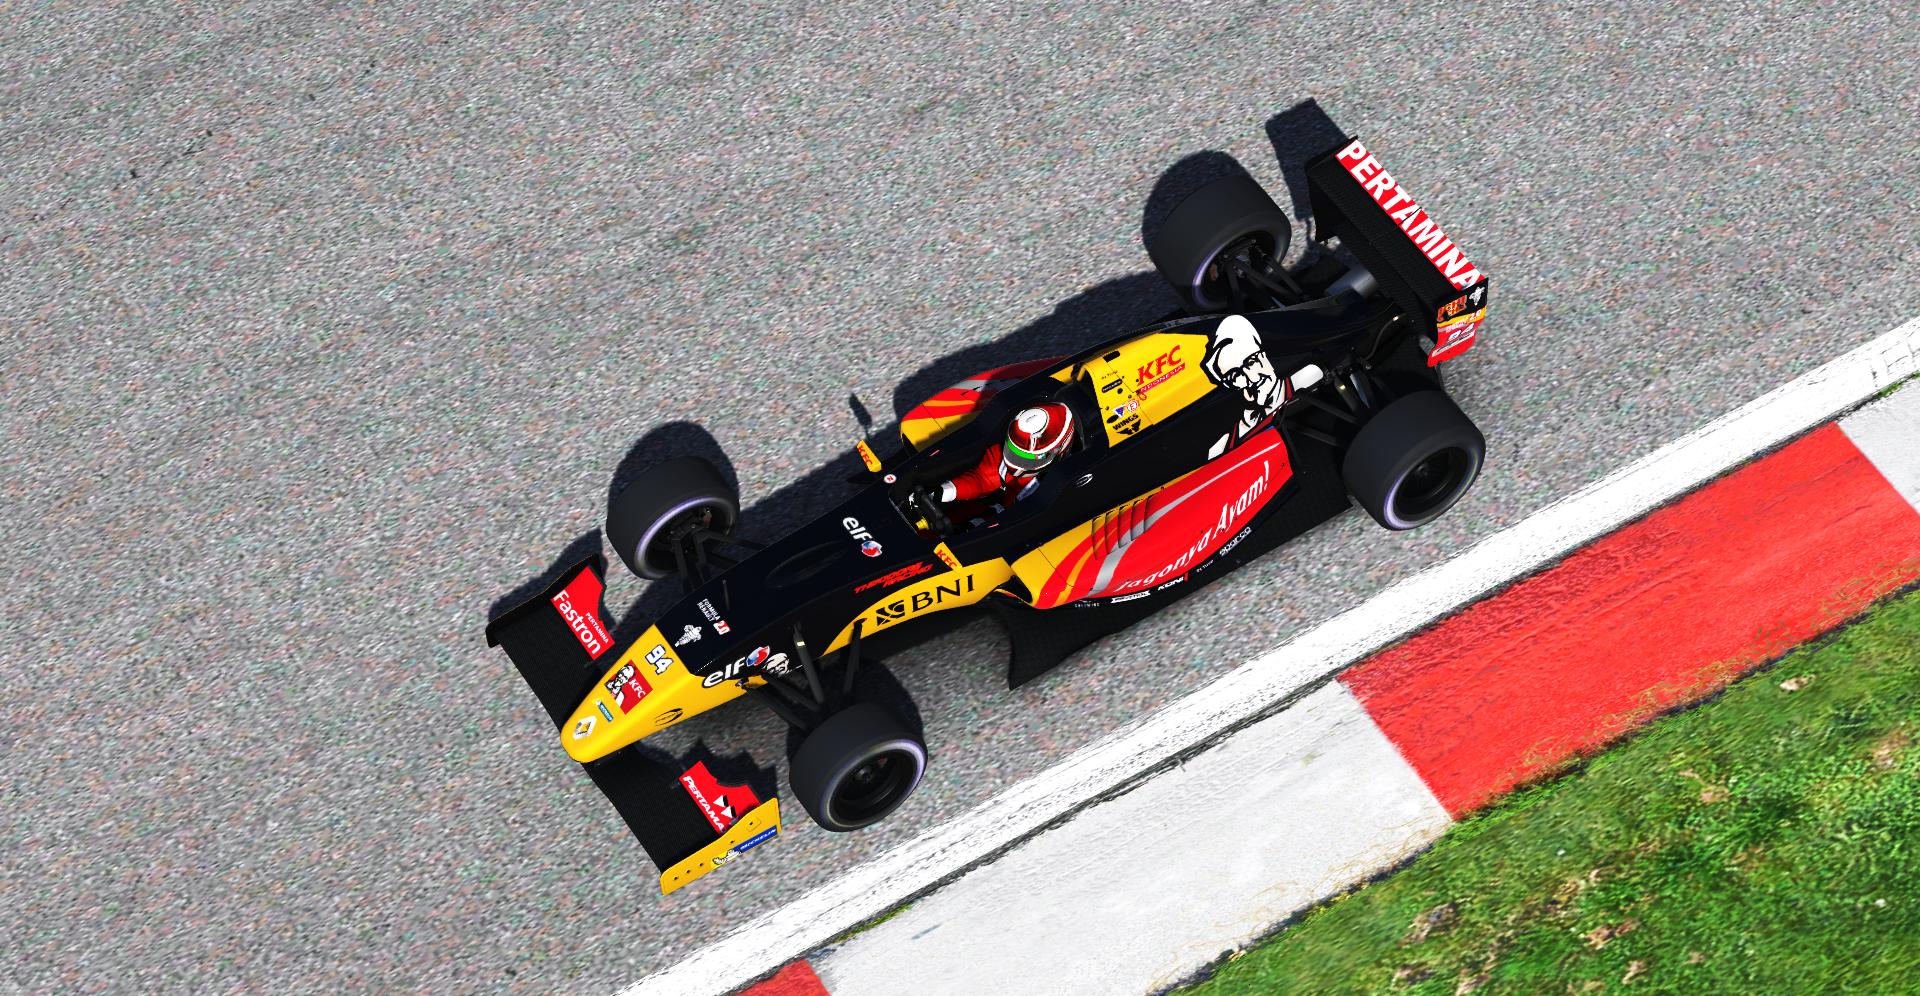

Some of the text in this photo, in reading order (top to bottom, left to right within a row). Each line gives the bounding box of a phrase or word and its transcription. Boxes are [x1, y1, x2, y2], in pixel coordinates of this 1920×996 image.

[1338, 139, 1483, 290] PERTAMINA
[1137, 344, 1182, 387] KFC
[1112, 412, 1139, 431] WINGS
[1211, 460, 1270, 541] Ayam!
[842, 516, 873, 541] elf
[936, 549, 958, 570] KFC
[911, 574, 974, 612] BNI
[1157, 576, 1184, 591] KONI
[553, 589, 601, 655] Fastron
[702, 598, 721, 621] FORMULA
[585, 612, 609, 644] PERTAMINA
[644, 643, 675, 676] 94
[702, 656, 746, 688] elf
[628, 678, 647, 699] KFC
